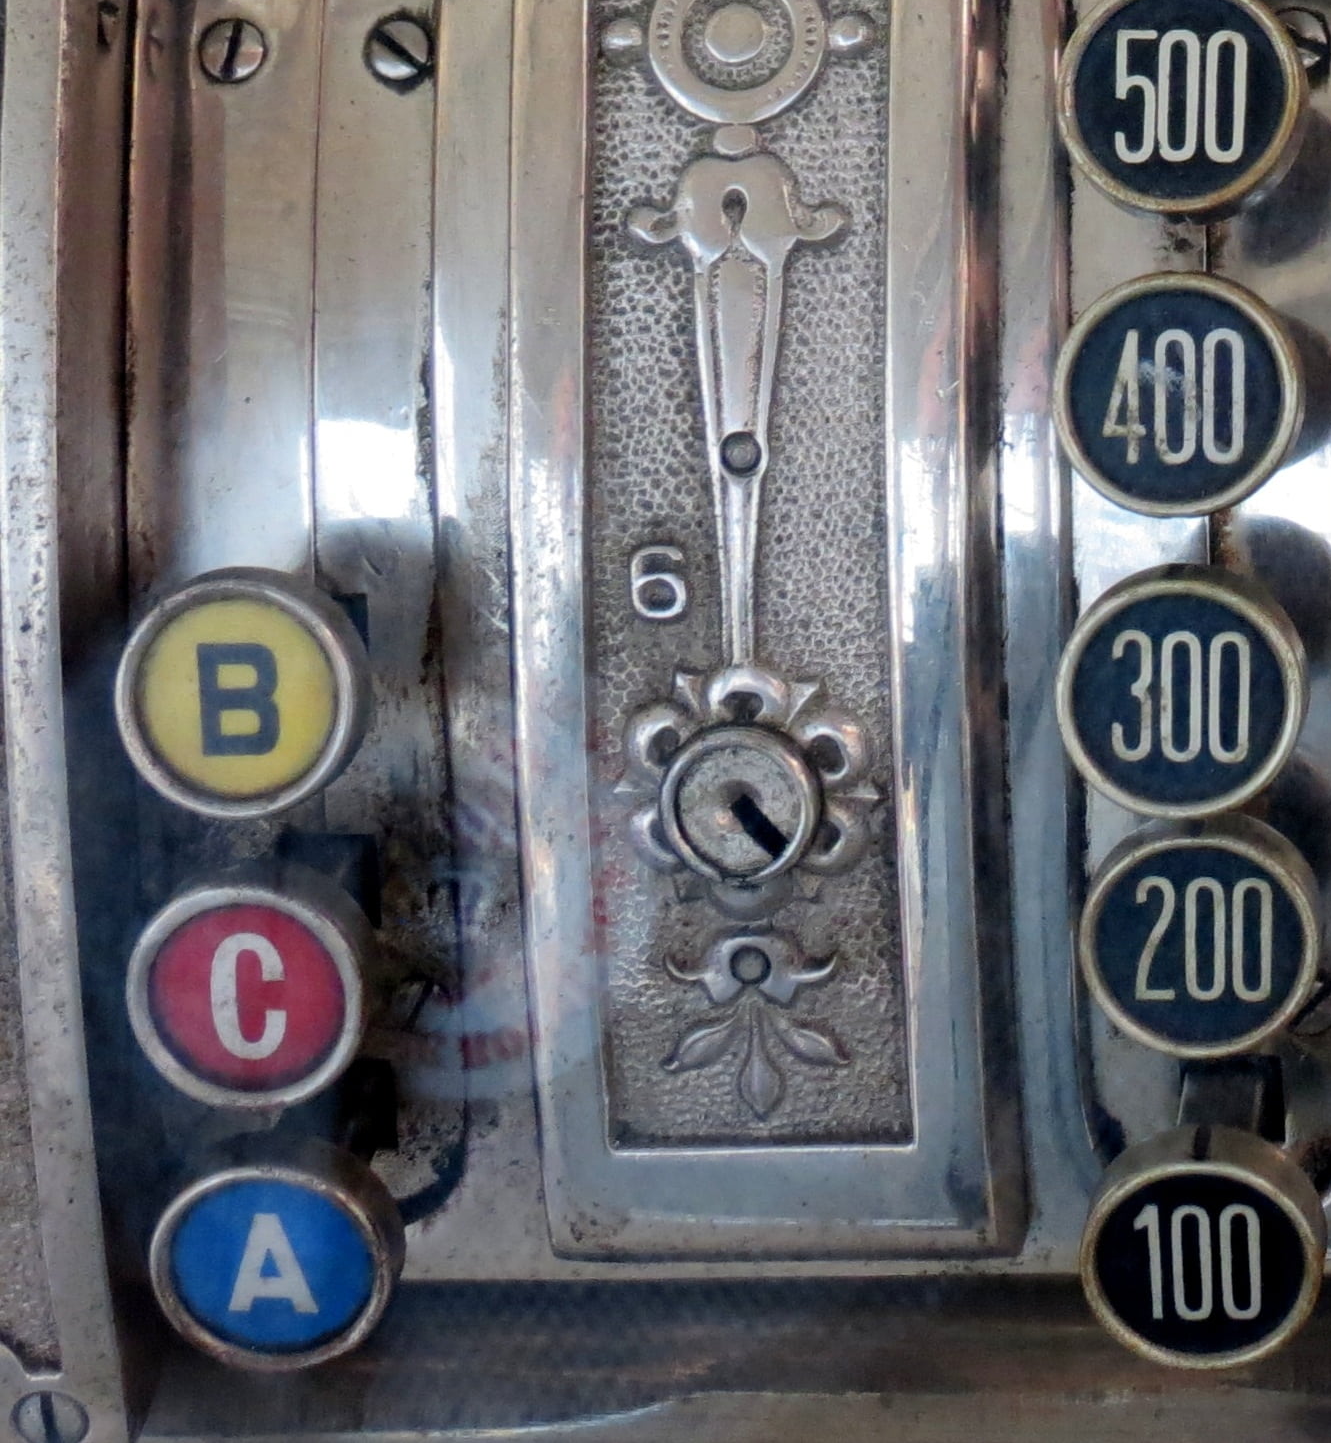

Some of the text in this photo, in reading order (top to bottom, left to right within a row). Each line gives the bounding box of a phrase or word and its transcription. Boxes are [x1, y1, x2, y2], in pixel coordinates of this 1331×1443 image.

[1115, 29, 1247, 163] 500
[1103, 328, 1245, 464] 400
[629, 544, 688, 620] 6
[197, 644, 279, 756] B
[1112, 630, 1250, 762] 300
[209, 931, 287, 1060] C
[1136, 876, 1272, 1001] 200
[229, 1213, 317, 1312] A
[1134, 1204, 1261, 1320] 100
